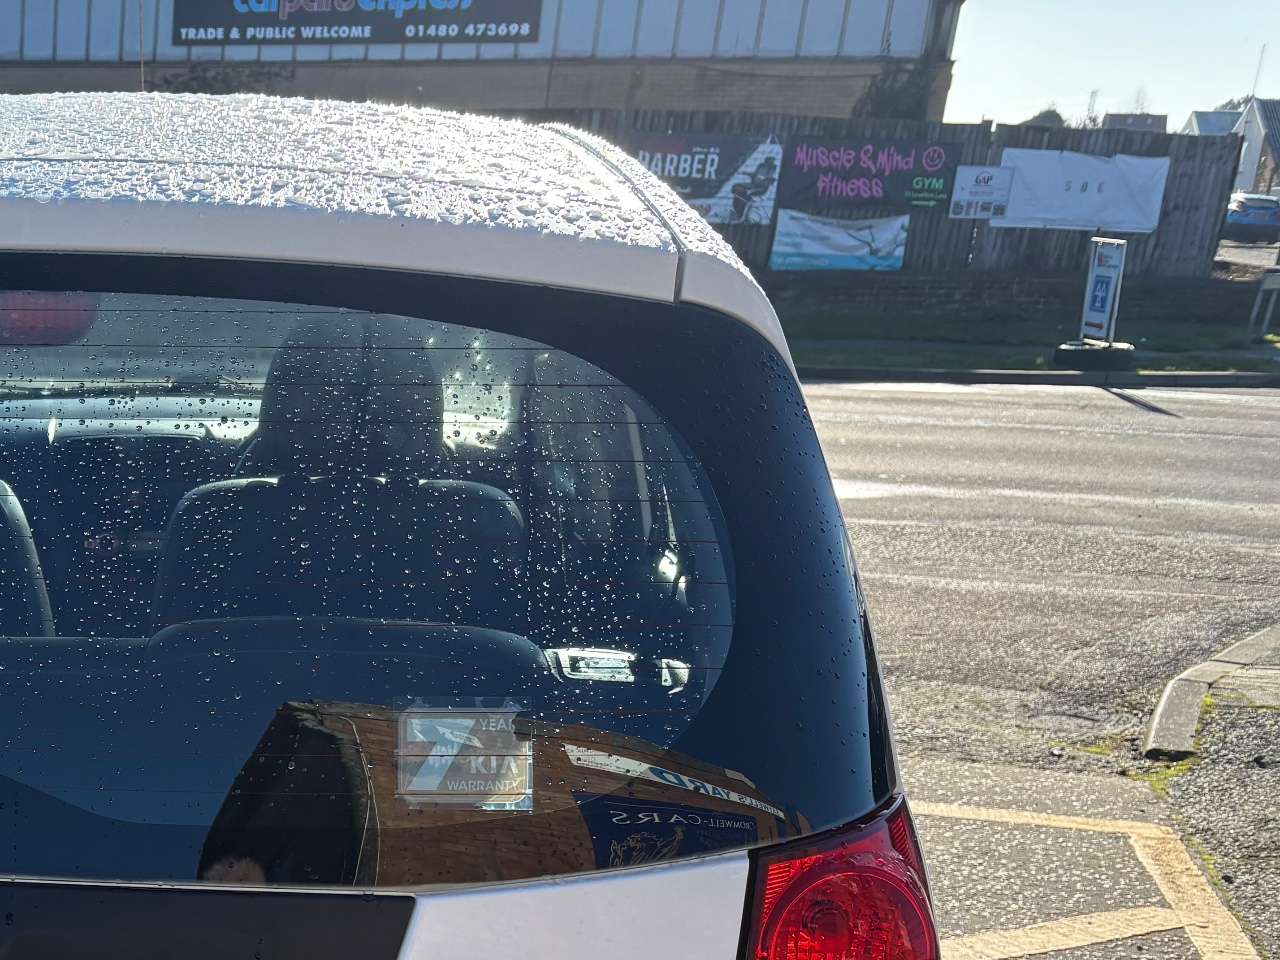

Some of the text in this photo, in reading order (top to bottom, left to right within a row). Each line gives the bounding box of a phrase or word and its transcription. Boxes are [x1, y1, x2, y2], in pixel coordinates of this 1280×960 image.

[180, 23, 531, 39] TRADE & PUBLIC WELCOME 01480 473698
[860, 144, 876, 173] &
[912, 176, 944, 189] GYM
[470, 756, 519, 774] KIA
[447, 780, 521, 791] WARRANTY
